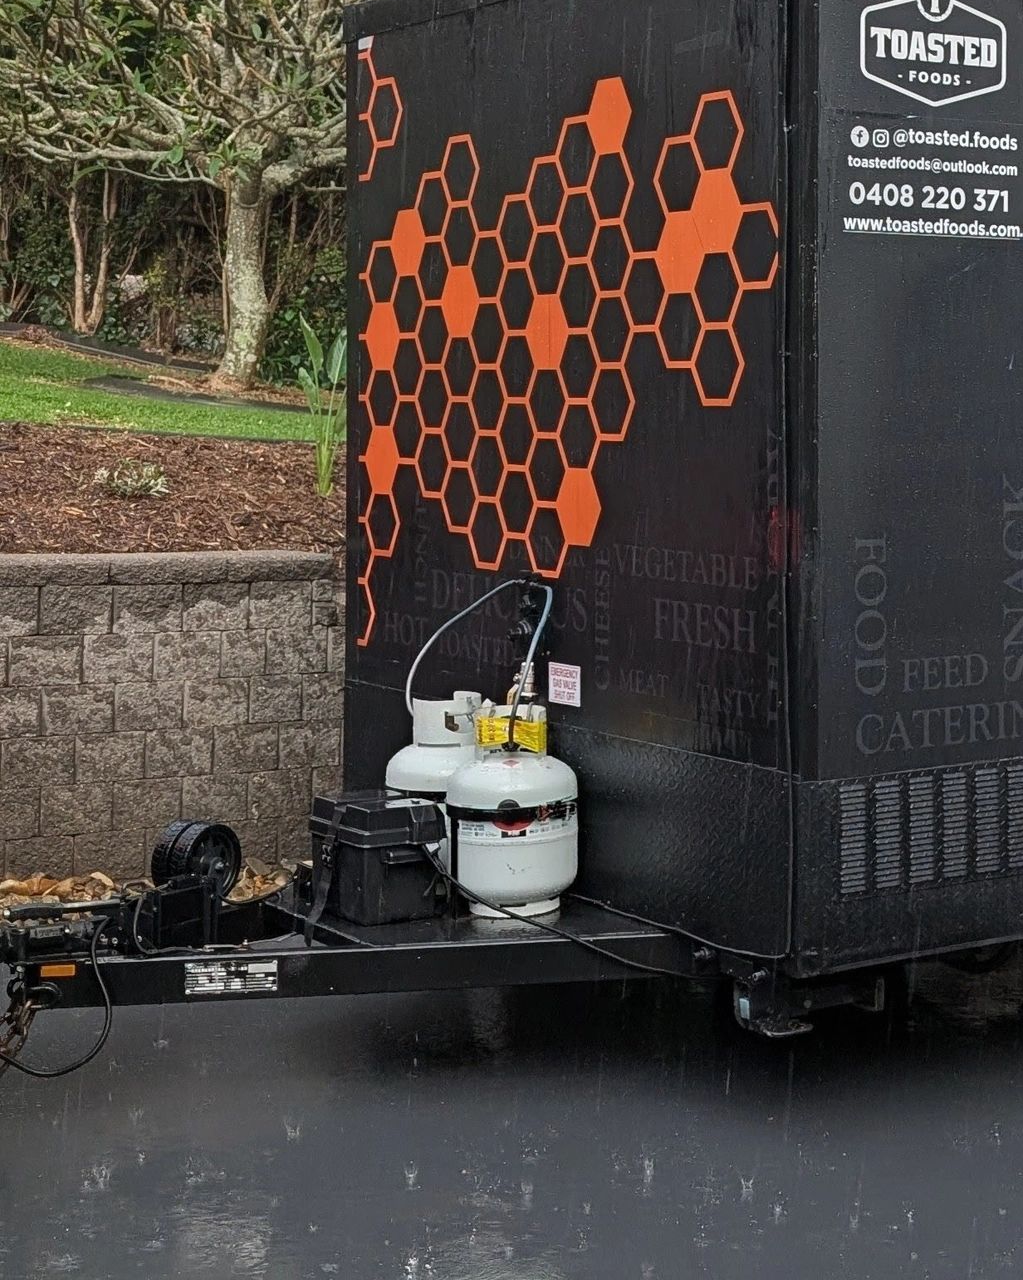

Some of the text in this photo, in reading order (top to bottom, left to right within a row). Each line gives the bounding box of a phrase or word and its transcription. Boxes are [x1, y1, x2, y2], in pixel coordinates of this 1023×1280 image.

[870, 26, 998, 69] TOASTED
[908, 70, 961, 87] FOODS
[893, 128, 1018, 151] @toasted.foods
[847, 154, 1018, 177] toastedfoods@outlook.com
[848, 181, 1010, 213] 0408 220 371
[613, 543, 759, 591] VEGETABLE
[430, 568, 588, 633] DELICIUS
[854, 532, 888, 697] FOOD
[383, 609, 428, 648] HOT
[652, 597, 758, 654] FRESH
[619, 668, 670, 698] MEAT
[901, 652, 990, 693] FEED
[696, 682, 761, 719] TASTY
